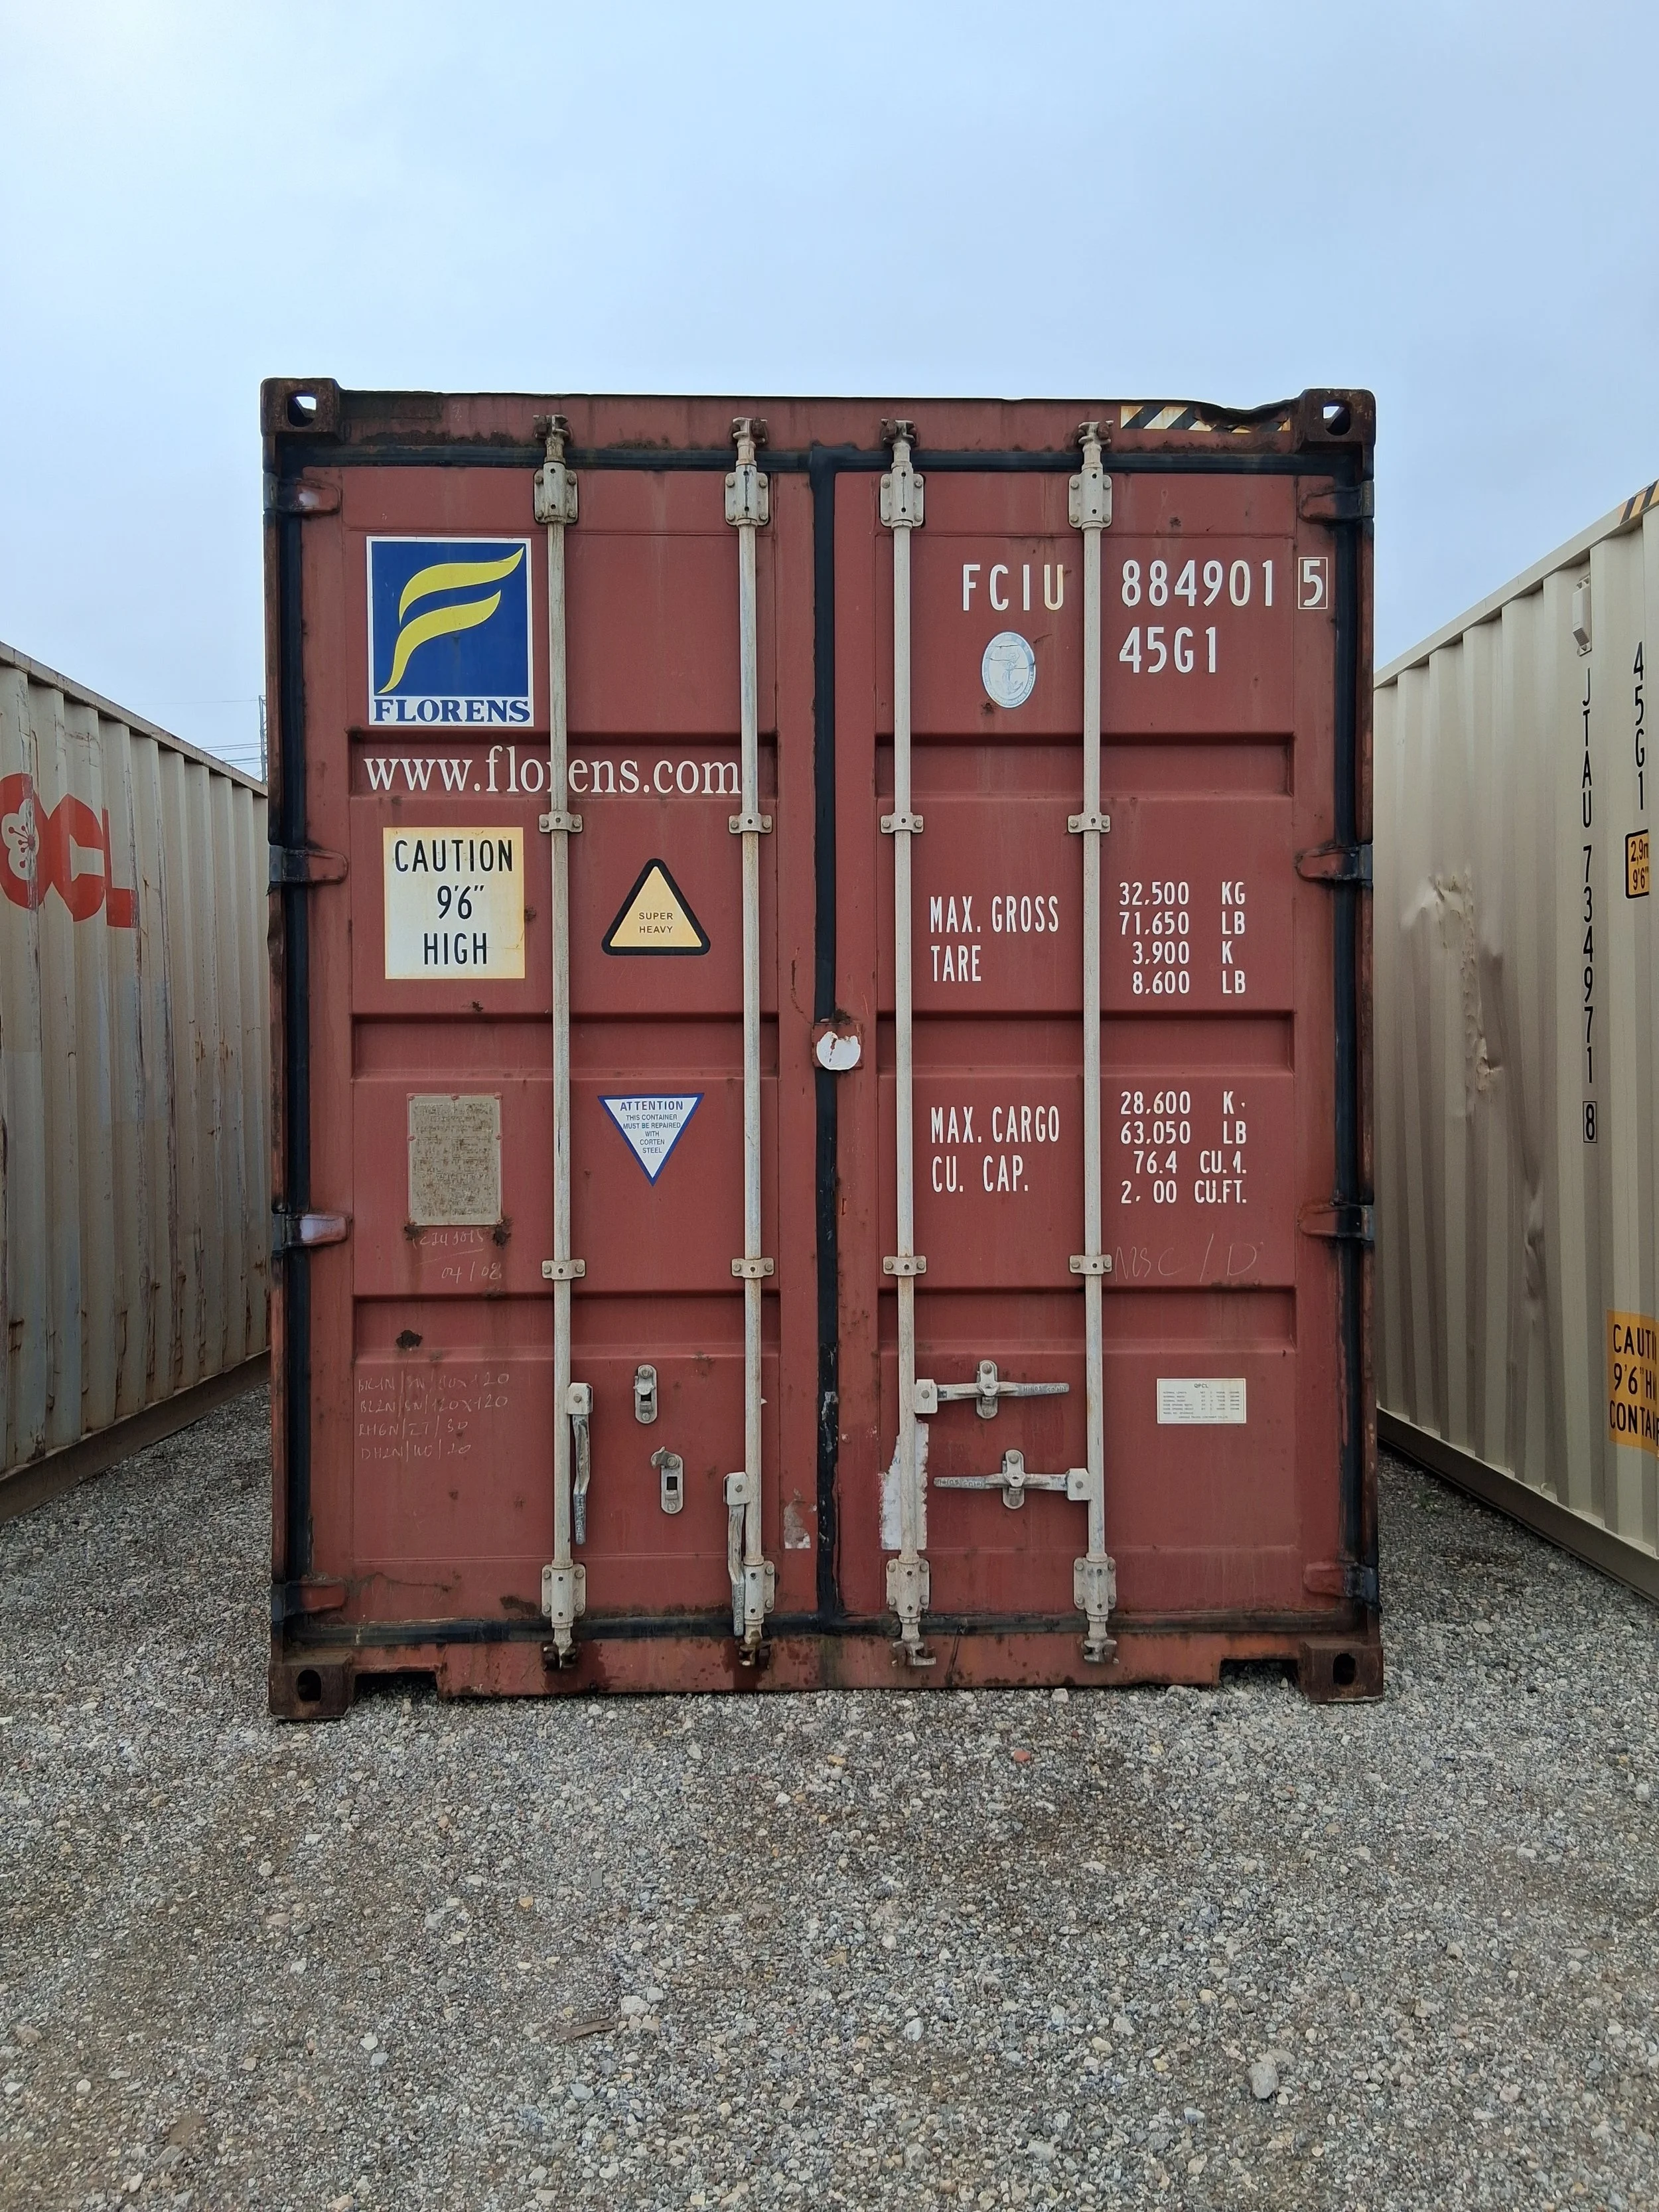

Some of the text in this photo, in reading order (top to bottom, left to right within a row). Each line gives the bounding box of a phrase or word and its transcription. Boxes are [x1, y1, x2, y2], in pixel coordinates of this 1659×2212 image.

[963, 559, 1324, 611] FCIU 884901 5
[1119, 627, 1216, 674] 45G1
[374, 699, 531, 723] FLORENS
[1633, 640, 1646, 811] 45G1
[363, 745, 741, 794] www.floens.com
[394, 840, 514, 873] CAUTION
[1119, 881, 1246, 905] 32,500 KG
[1581, 666, 1596, 1141] JTAU 734971 8
[638, 911, 674, 921] SUPER
[638, 925, 674, 934] HEAVY
[930, 895, 1060, 933] MAX. GROSS
[1119, 911, 1246, 935] 71,650 LB
[423, 932, 488, 966] HIGH
[930, 945, 982, 982] TARE
[1132, 940, 1189, 964] 3,900
[1132, 970, 1246, 994] 8,600 LB
[620, 1101, 684, 1112] ATTENTION
[1120, 1091, 1191, 1115] 28,600
[930, 1105, 1060, 1144] MAX. CARGO
[1120, 1120, 1247, 1145] 63,050 LB
[930, 1154, 1029, 1193] CU. CAP.
[1133, 1150, 1177, 1174] 76.4
[1613, 1323, 1656, 1364] CAUTI
